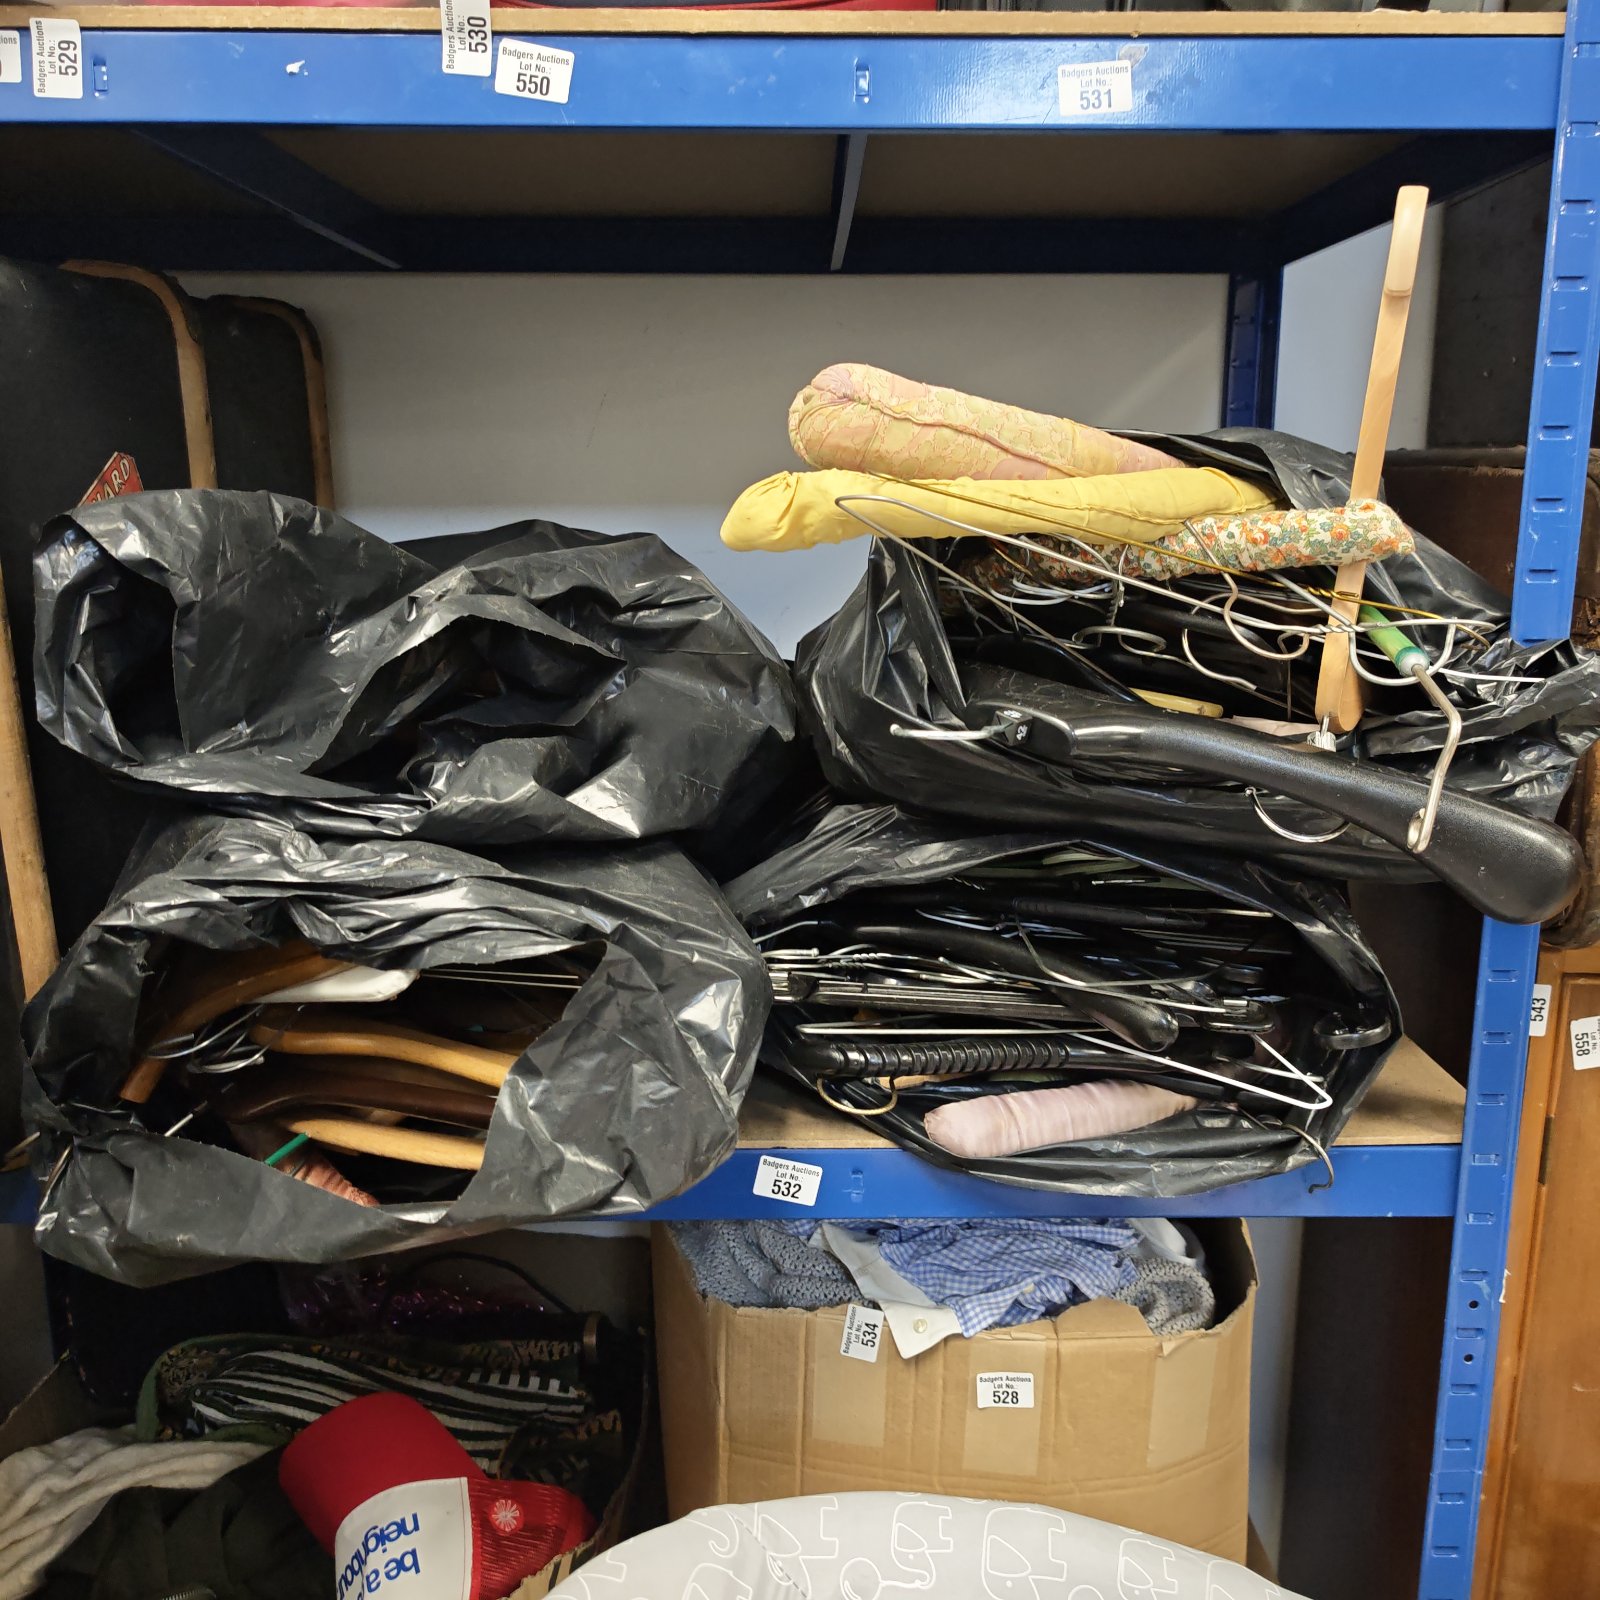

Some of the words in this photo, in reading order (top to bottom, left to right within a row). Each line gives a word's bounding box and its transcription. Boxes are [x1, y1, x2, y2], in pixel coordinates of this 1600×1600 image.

[445, 0, 454, 32] Auction
[36, 20, 45, 57] Auctions
[458, 37, 466, 50] Lot
[467, 16, 488, 53] 530
[58, 40, 78, 76] 529
[446, 35, 456, 69] Badgers
[502, 46, 534, 60] Badgers
[536, 52, 570, 66] Auctions
[37, 59, 47, 93] Badgers
[48, 61, 56, 74] Lot
[519, 61, 532, 71] Lot
[1061, 68, 1093, 79] Badgers
[1095, 65, 1129, 75] Auctions
[516, 72, 550, 96] 550
[1080, 79, 1092, 88] Lot
[1080, 88, 1112, 110] 531
[1530, 998, 1546, 1022] 543
[1574, 1032, 1590, 1057] 558
[762, 1158, 790, 1170] Badgers
[791, 1164, 820, 1177] Auctions
[776, 1170, 787, 1179] Lot
[771, 1179, 802, 1199] 532
[861, 1322, 879, 1348] 534
[1005, 1375, 1032, 1383] Auctions
[992, 1390, 1019, 1404] 528
[336, 1512, 420, 1600] neighbou
[384, 1547, 421, 1581] be
[365, 1568, 381, 1593] a
